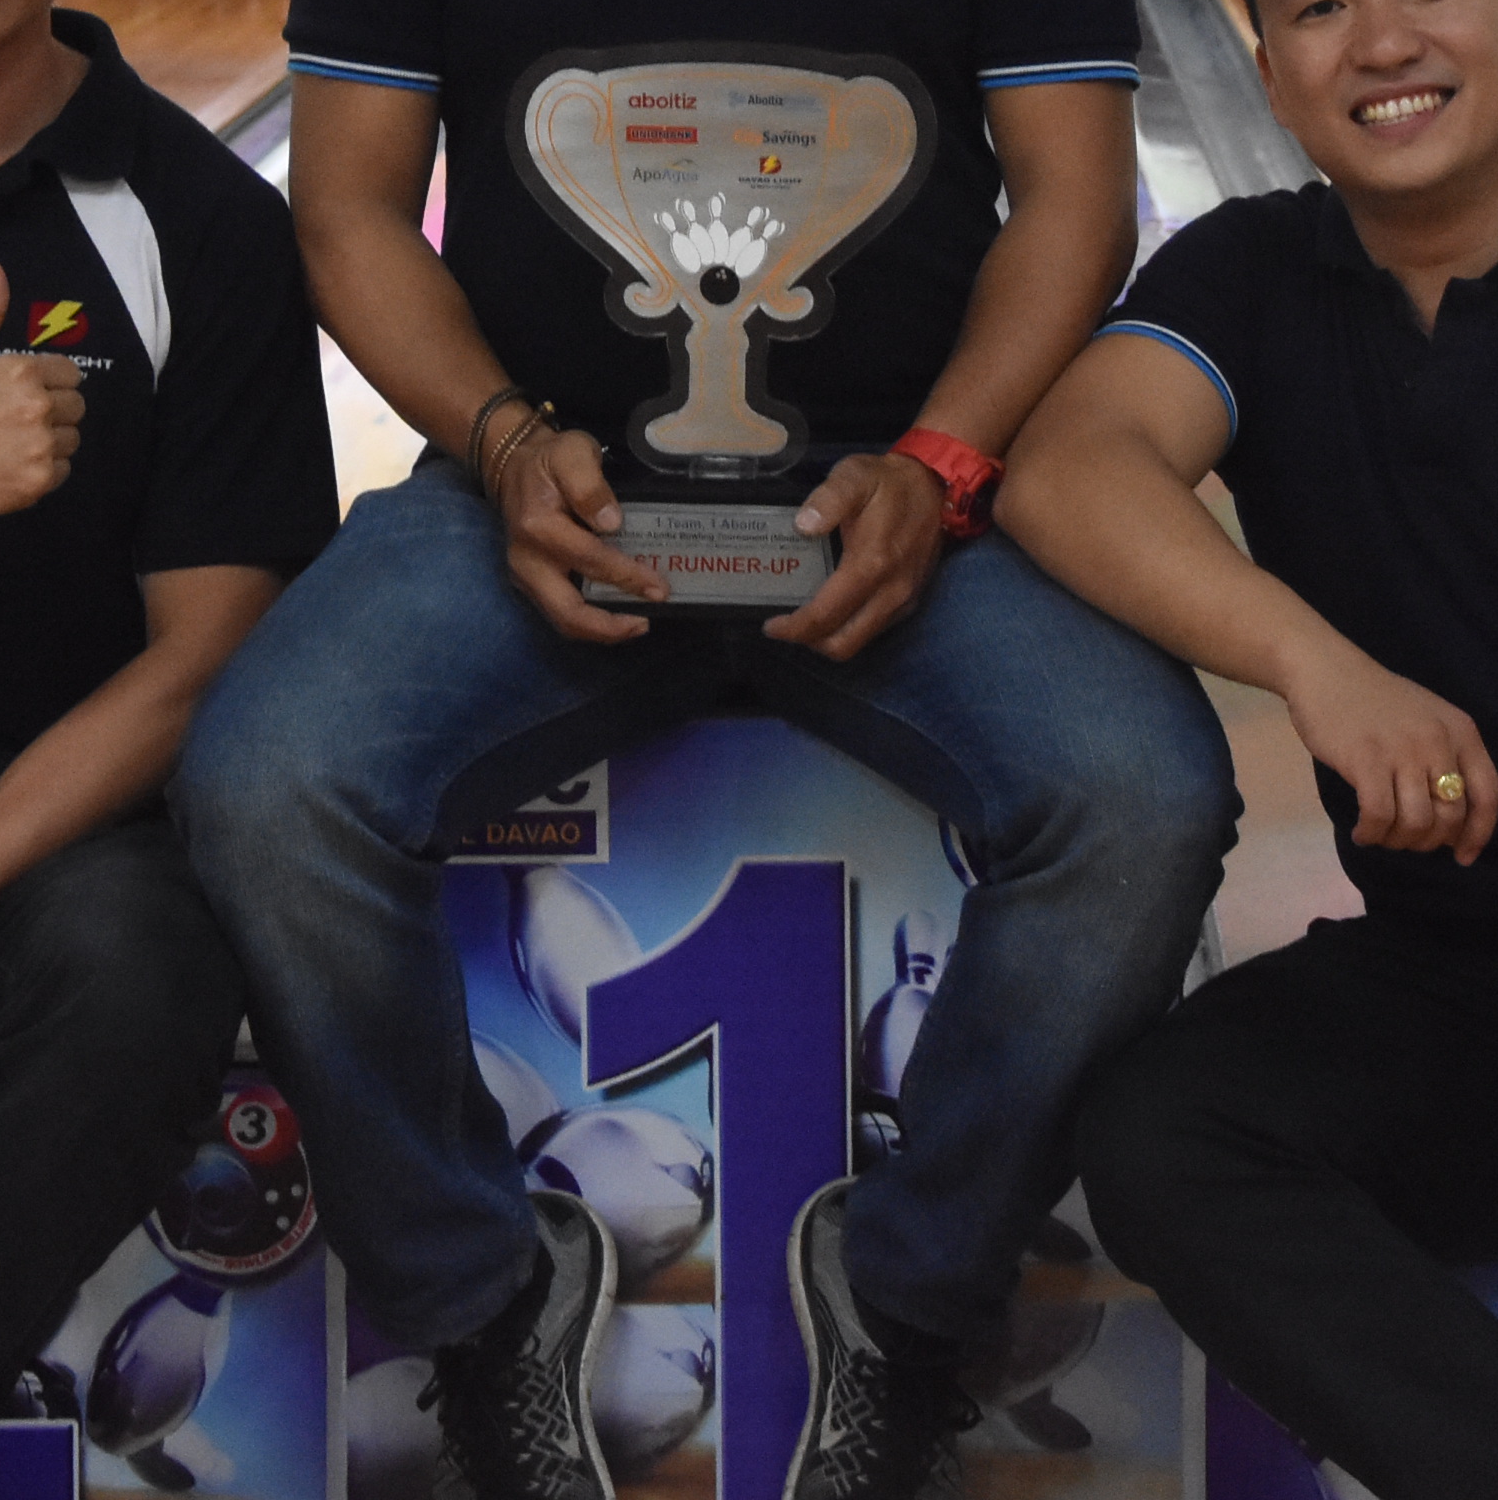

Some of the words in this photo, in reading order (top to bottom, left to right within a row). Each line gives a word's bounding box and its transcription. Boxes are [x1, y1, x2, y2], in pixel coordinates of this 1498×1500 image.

[628, 92, 697, 110] aboitiz
[631, 130, 694, 140] UNIONBANK
[635, 554, 662, 571] ST
[669, 555, 800, 575] RUNNER-UP
[486, 821, 581, 846] DAVAO
[235, 1104, 269, 1145] 3
[581, 856, 850, 1500] 1
